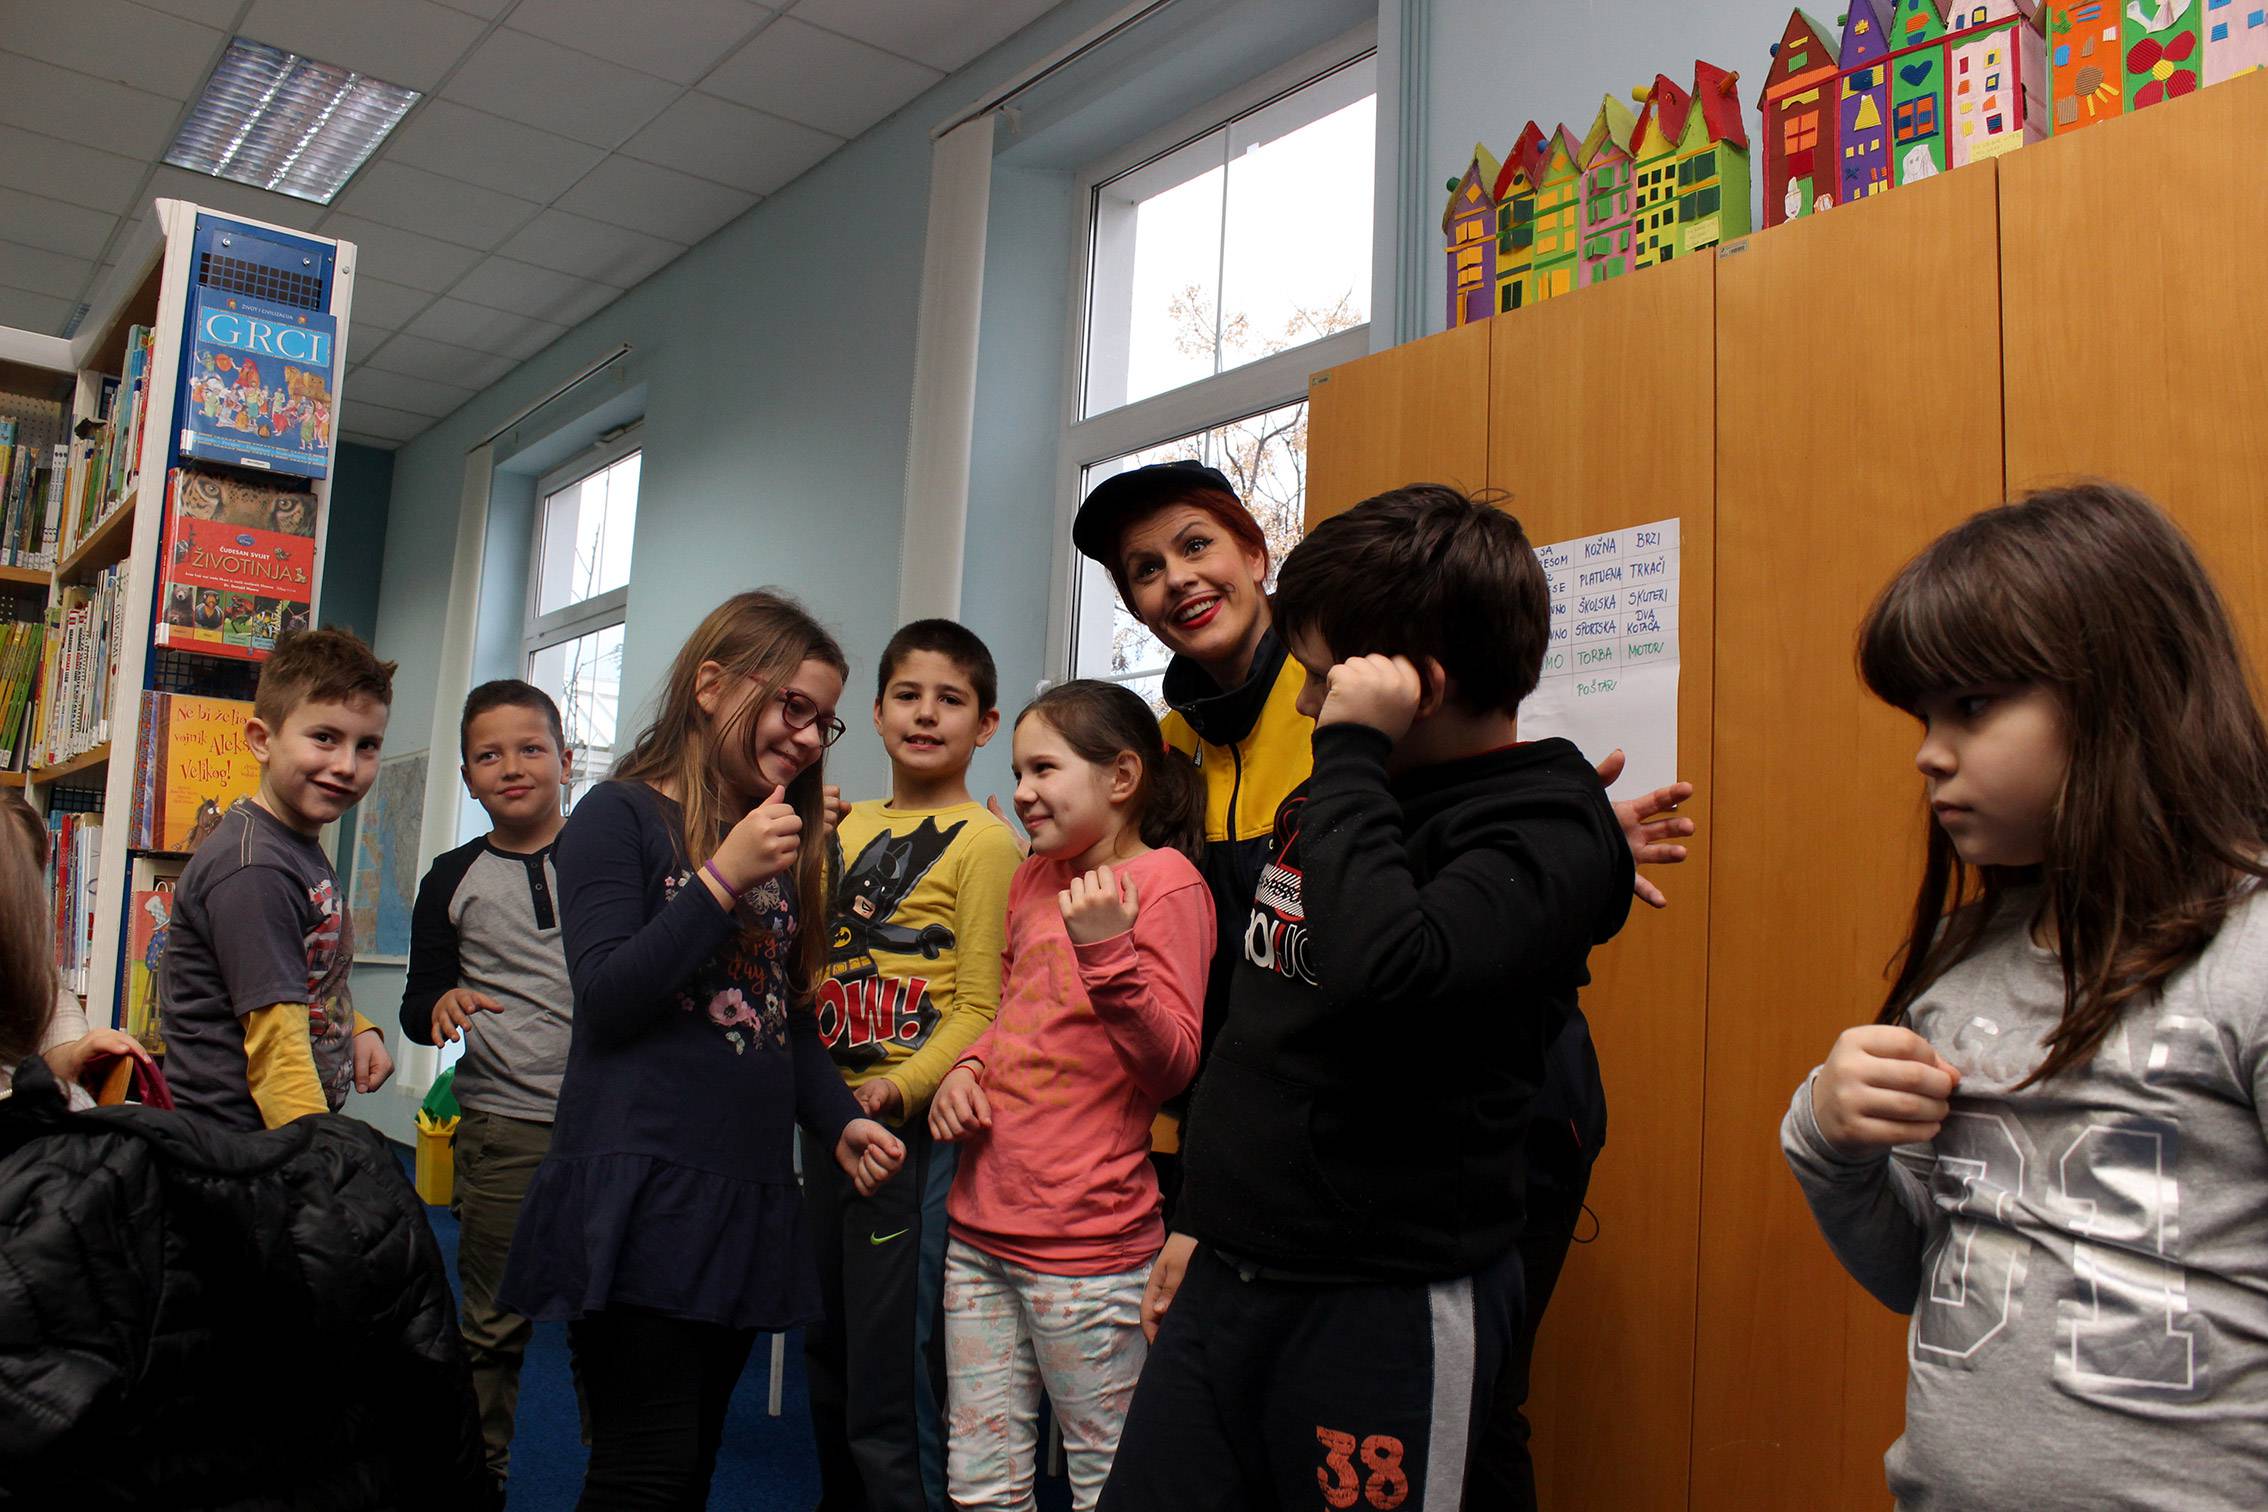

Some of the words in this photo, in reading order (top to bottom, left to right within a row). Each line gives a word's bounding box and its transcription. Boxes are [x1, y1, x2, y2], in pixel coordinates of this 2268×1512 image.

[206, 313, 325, 363] GRCI
[219, 546, 249, 557] ČUDESAN
[1585, 537, 1616, 558] KOŽNA
[1636, 532, 1660, 548] BRZI
[192, 547, 292, 582] ŽIVOTINJA
[1630, 555, 1665, 578] TRKAČI
[1578, 594, 1616, 613] ŠKOLSKA
[1628, 589, 1667, 607] SKUTERI
[1635, 608, 1656, 621] DVA
[111, 603, 122, 659] ORIGAMI
[1575, 620, 1616, 636] SPORTSKA
[1577, 647, 1612, 666] TORBA
[1628, 642, 1664, 659] MOTORI
[1577, 679, 1617, 697] POŠTARI
[177, 707, 194, 721] Ne
[199, 704, 211, 722] bi
[174, 730, 207, 746] vojnik
[210, 730, 251, 756] Aleks
[181, 758, 231, 787] Velikog!
[815, 974, 930, 1049] OW!
[1315, 1425, 1409, 1511] 38
